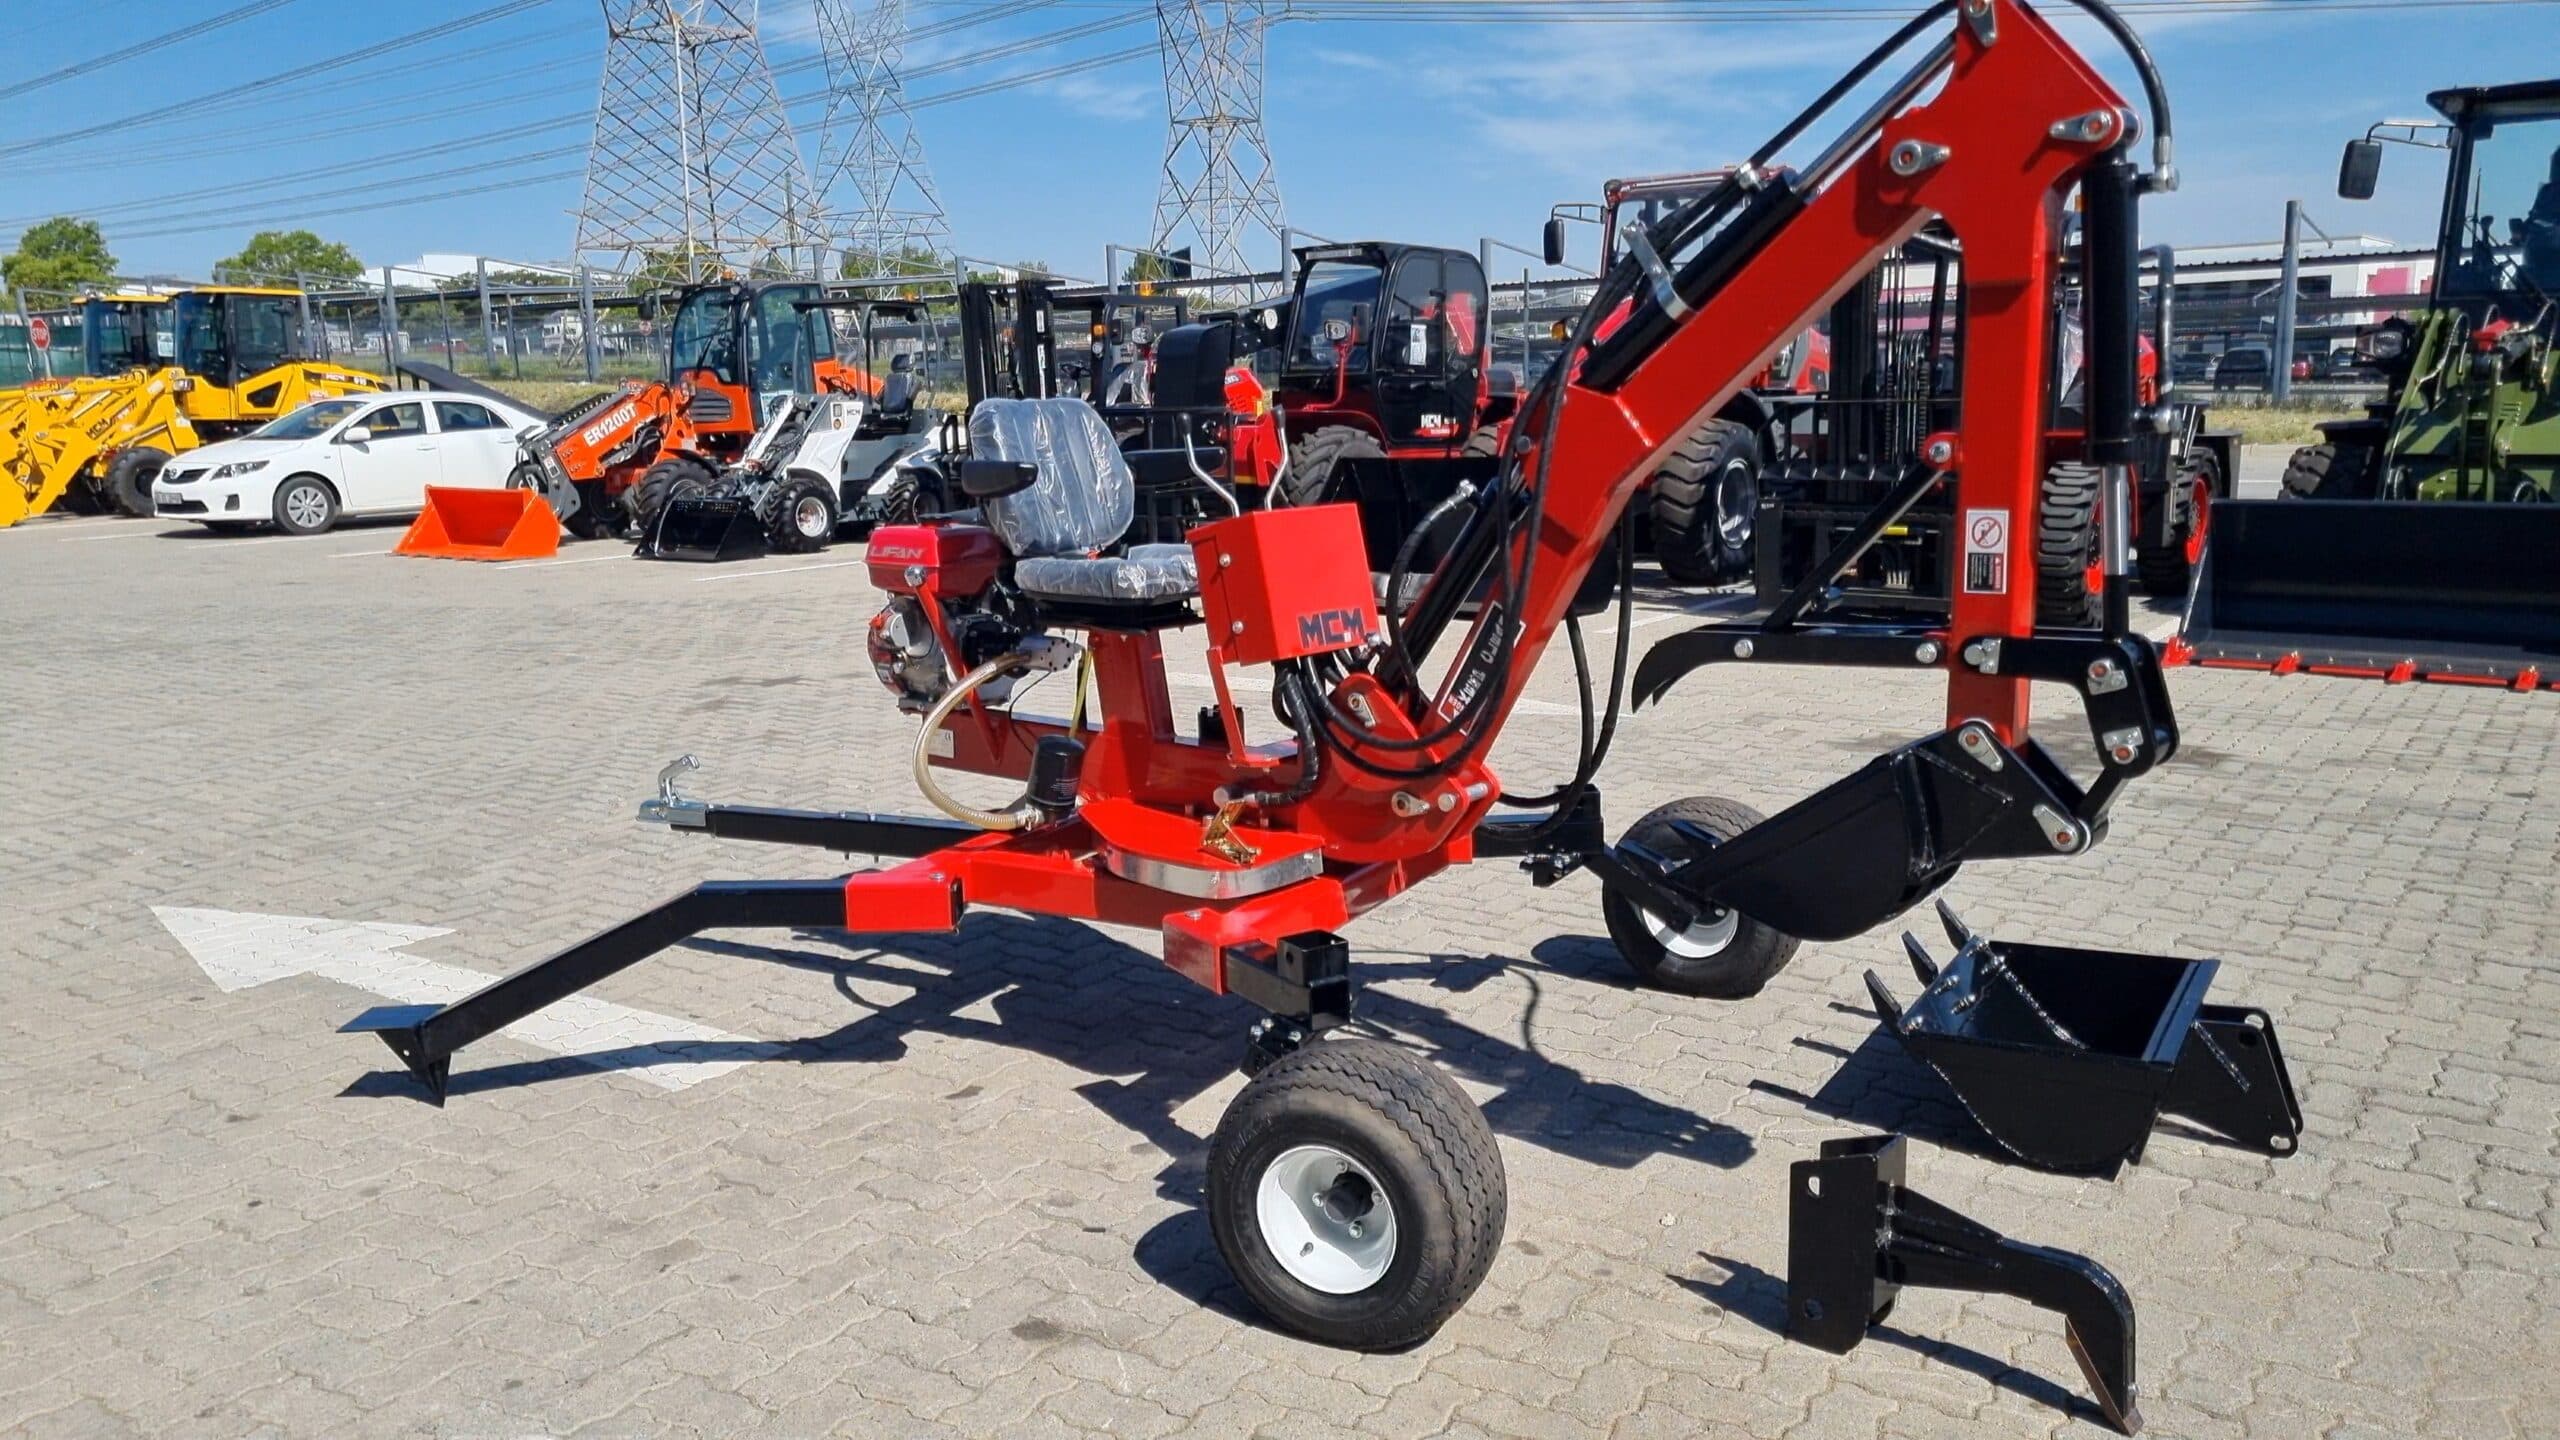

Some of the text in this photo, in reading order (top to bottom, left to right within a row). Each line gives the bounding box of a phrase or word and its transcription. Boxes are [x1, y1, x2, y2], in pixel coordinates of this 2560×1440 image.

[583, 402, 637, 447] ER1200T
[870, 545, 927, 559] LIFAN
[1297, 607, 1366, 649] MCM
